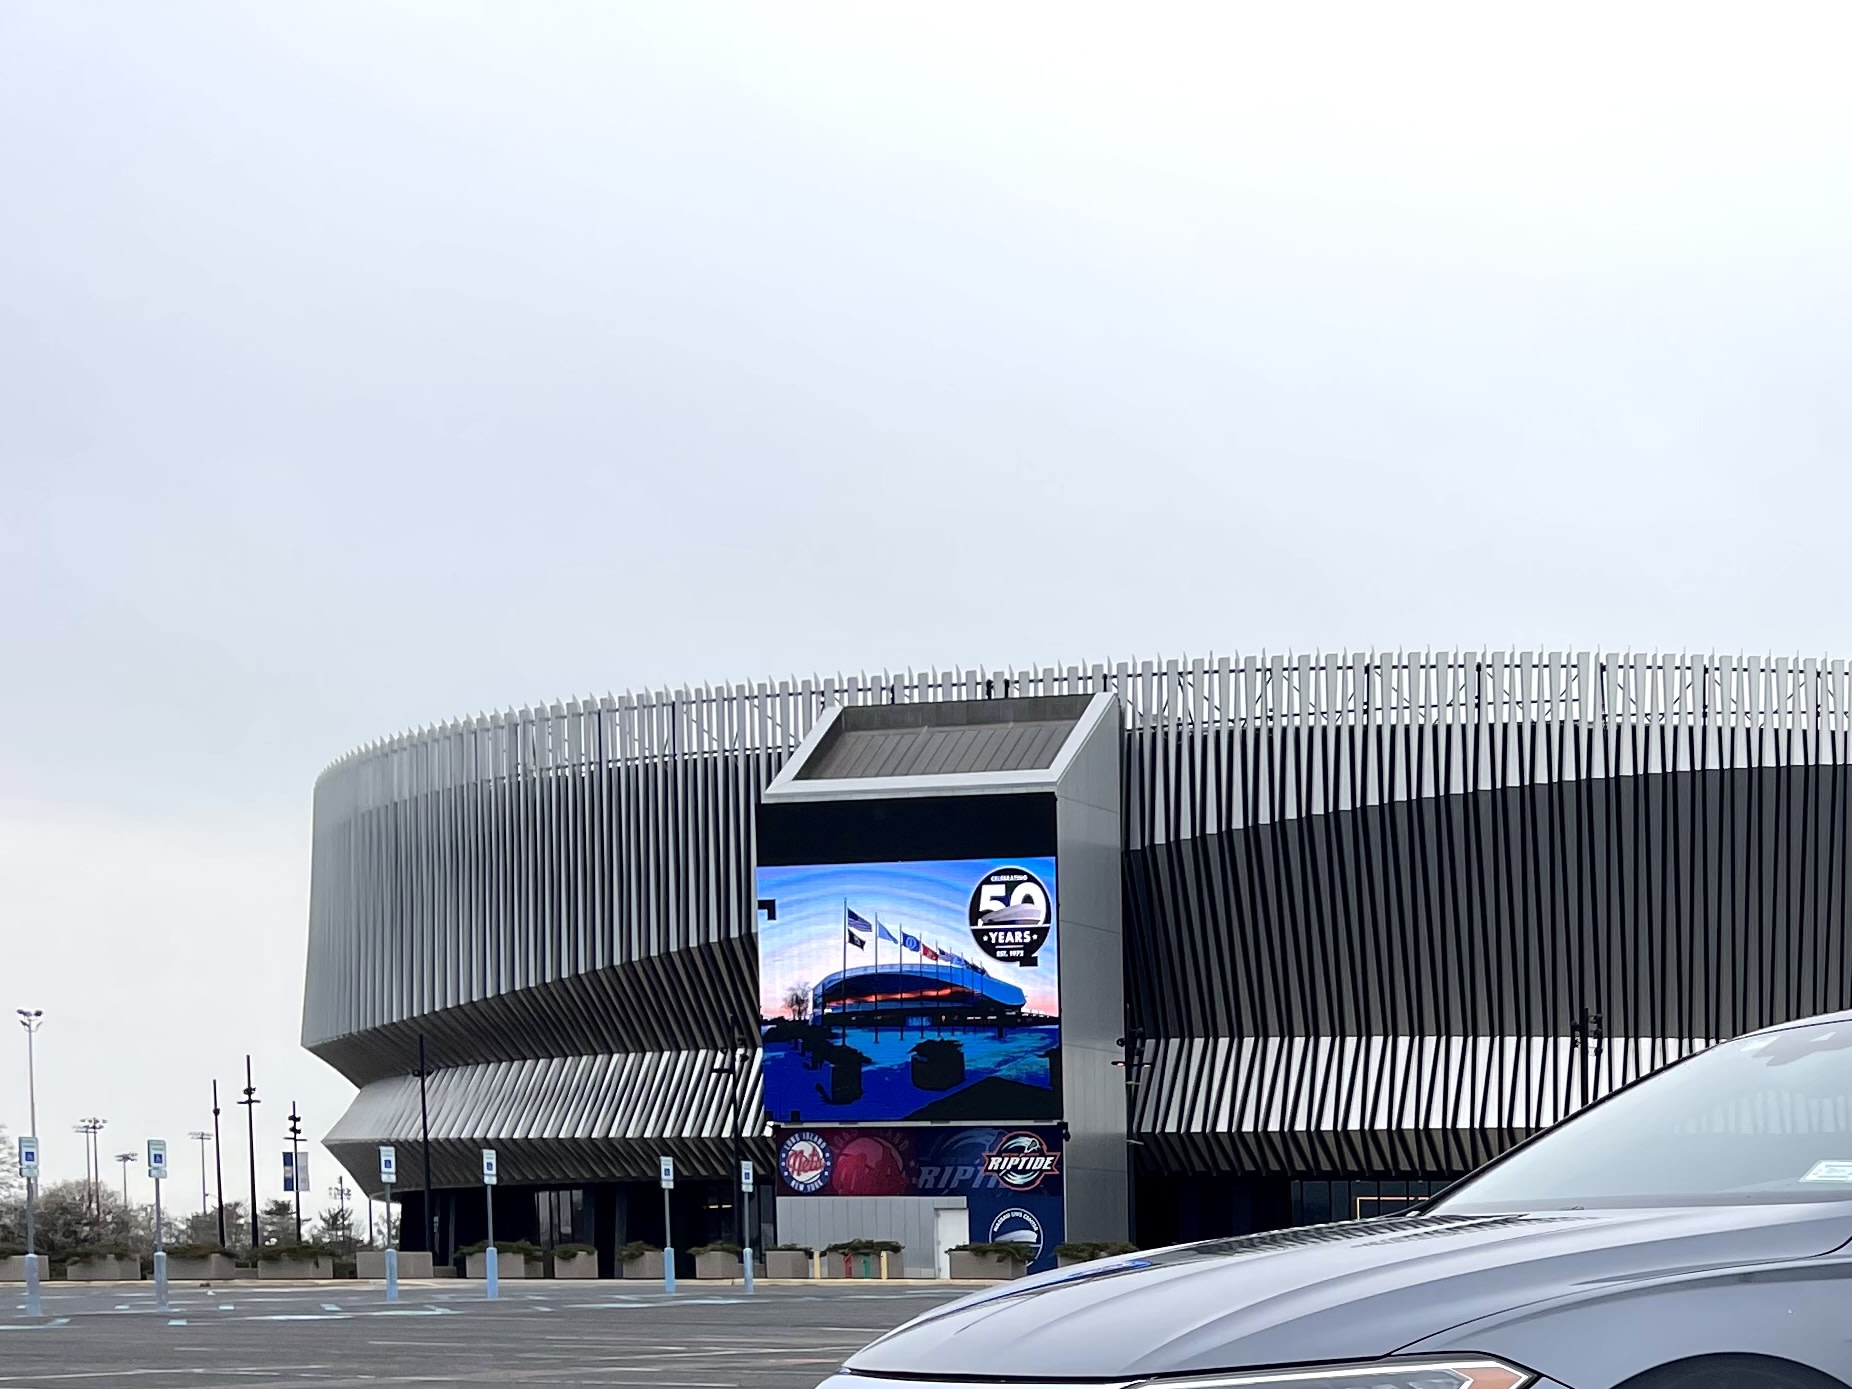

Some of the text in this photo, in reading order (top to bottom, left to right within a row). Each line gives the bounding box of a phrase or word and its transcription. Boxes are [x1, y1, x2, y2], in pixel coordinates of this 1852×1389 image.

[978, 881, 1047, 927] 50
[988, 931, 1031, 944] YEARS
[988, 1156, 1055, 1171] RIPTIDE
